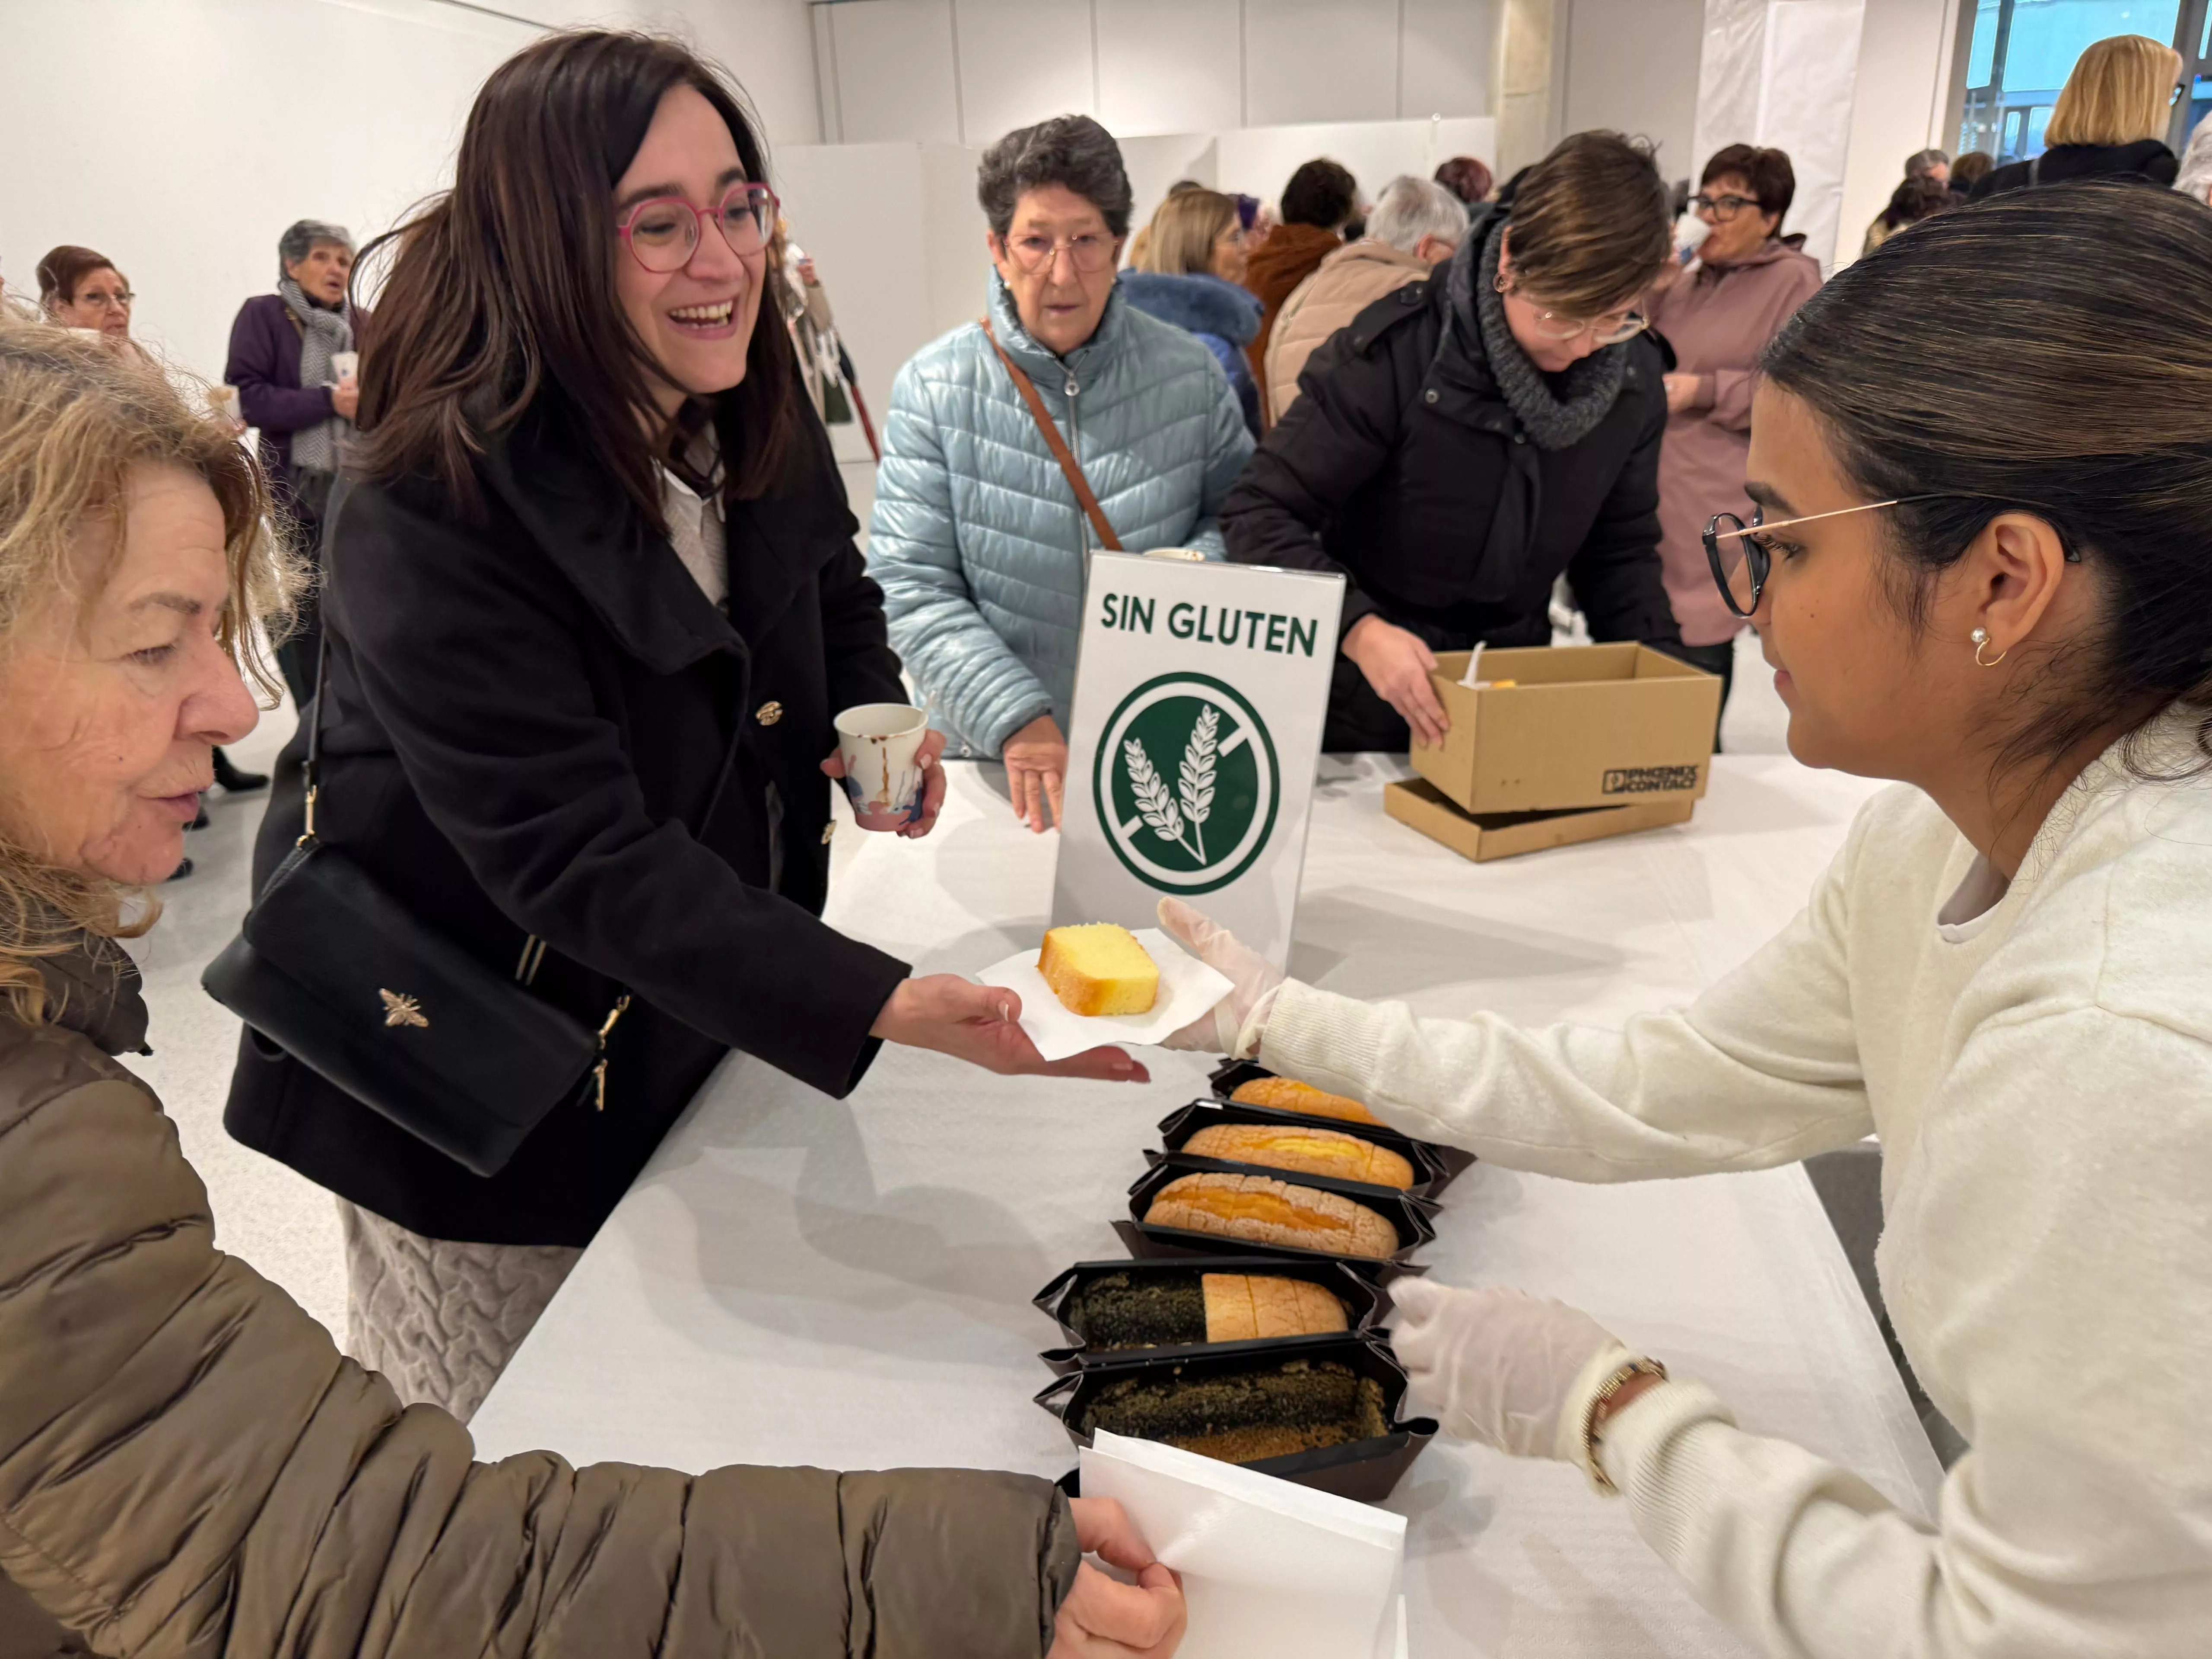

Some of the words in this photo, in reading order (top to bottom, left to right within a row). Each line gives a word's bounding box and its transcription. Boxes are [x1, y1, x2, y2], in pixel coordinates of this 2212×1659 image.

[1101, 593, 1155, 634] SIN
[1168, 603, 1318, 657] GLUTEN
[1626, 778, 1696, 793] CONTACT
